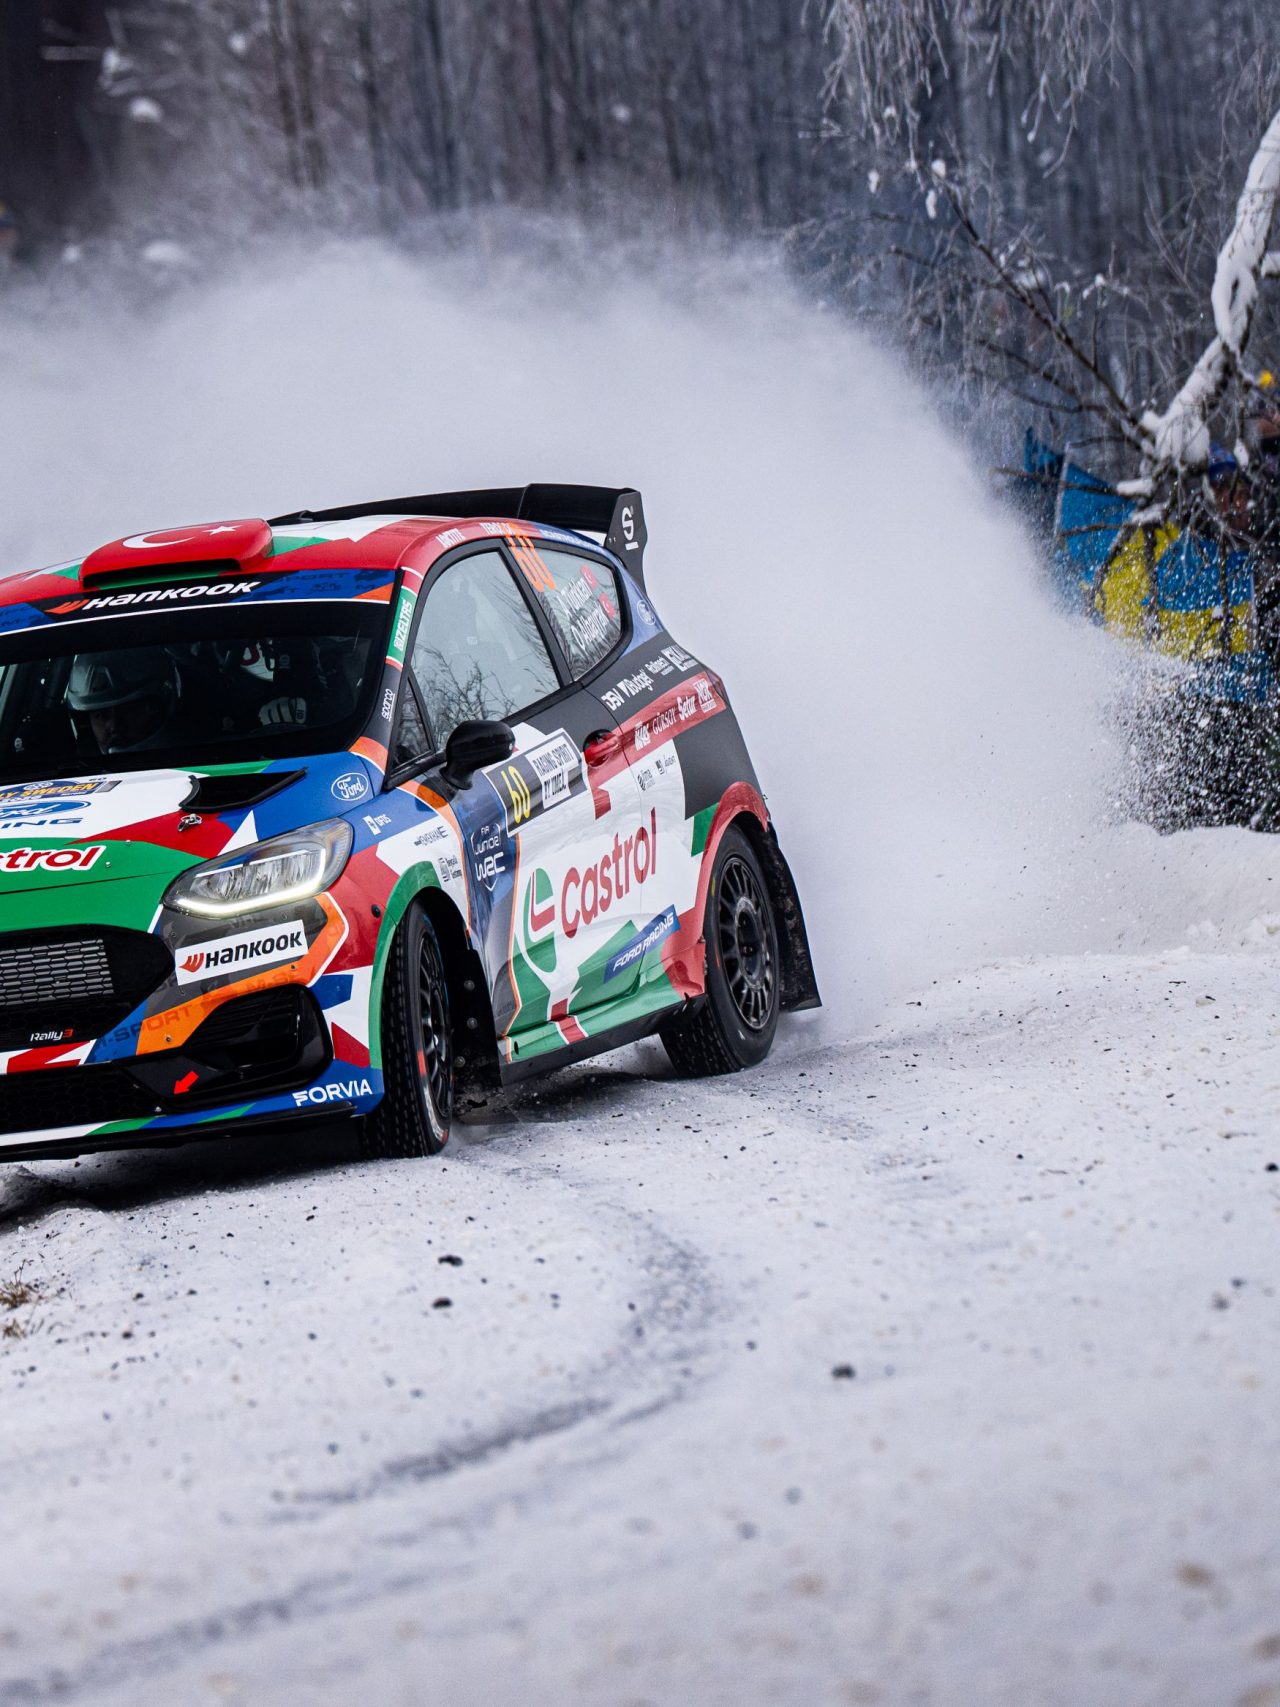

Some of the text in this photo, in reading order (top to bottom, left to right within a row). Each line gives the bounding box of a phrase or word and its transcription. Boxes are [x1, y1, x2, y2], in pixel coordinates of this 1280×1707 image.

[500, 522, 556, 592] 60
[82, 581, 262, 611] HANKOOK
[381, 689, 394, 720] sparco
[601, 688, 625, 711] DSV
[627, 668, 655, 697] Budget
[677, 695, 697, 721] Setur
[532, 743, 575, 777] RACING SPIRIT
[20, 782, 97, 798] SWEDEN
[336, 776, 365, 799] Ford
[501, 765, 531, 824] 60
[474, 852, 506, 882] WRC
[561, 807, 657, 939] Castrol
[204, 930, 303, 969] HANKOOK
[612, 911, 675, 972] FORD RACING
[30, 1028, 73, 1042] Rally3
[291, 1079, 373, 1107] FORVIA
